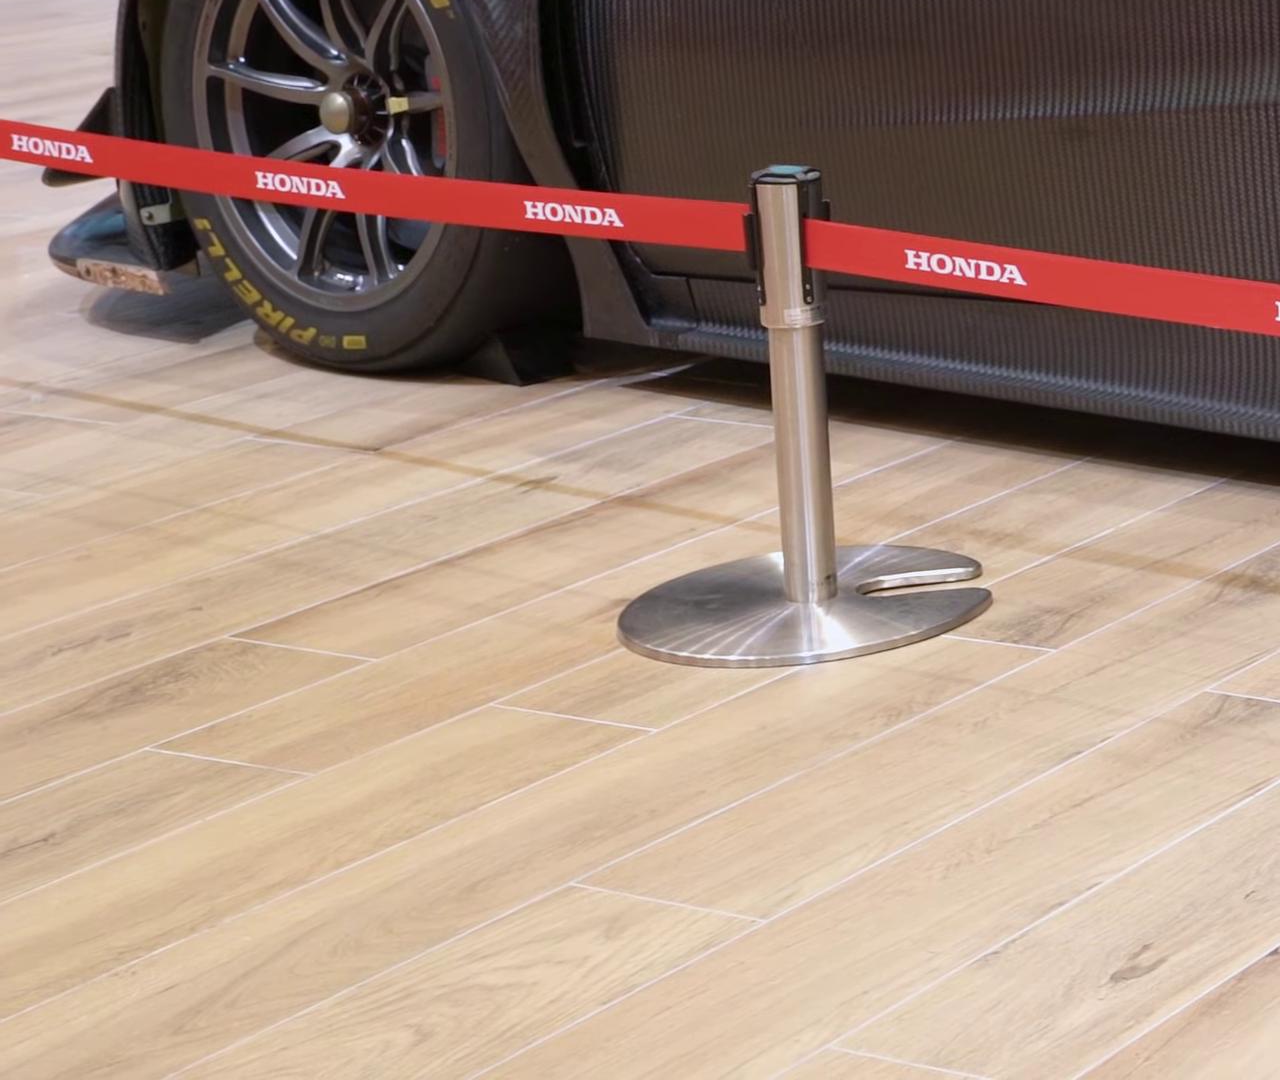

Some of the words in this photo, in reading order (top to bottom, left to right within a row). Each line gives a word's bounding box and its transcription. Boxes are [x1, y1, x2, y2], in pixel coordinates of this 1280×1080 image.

[10, 133, 94, 164] HONDA
[255, 171, 346, 199] HONDA
[523, 200, 625, 228] HONDA
[193, 218, 318, 345] PIRELLI
[904, 249, 1028, 287] HONDA
